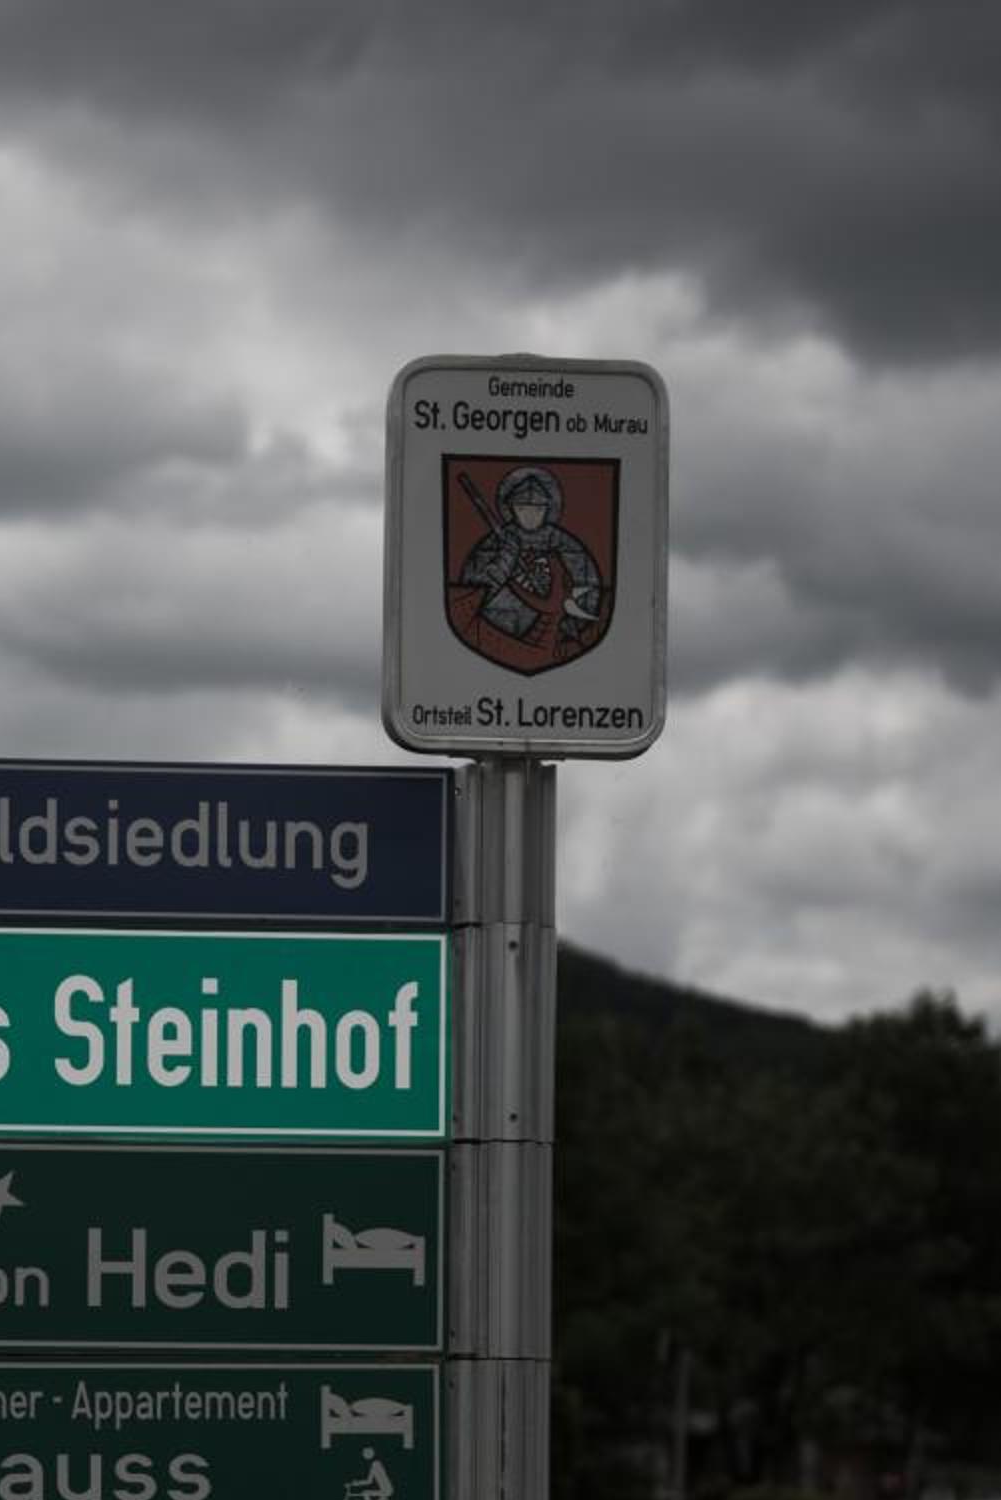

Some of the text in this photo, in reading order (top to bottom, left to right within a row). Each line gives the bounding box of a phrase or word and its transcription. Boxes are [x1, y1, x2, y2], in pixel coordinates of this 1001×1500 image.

[488, 376, 575, 399] Gemeinde
[414, 400, 649, 438] St. Georgen ob Murau
[413, 697, 644, 729] Ortsteil St. Lorenzen
[52, 973, 420, 1091] Steinhof
[86, 1226, 291, 1311] Hedi
[70, 1378, 289, 1430] Appartement
